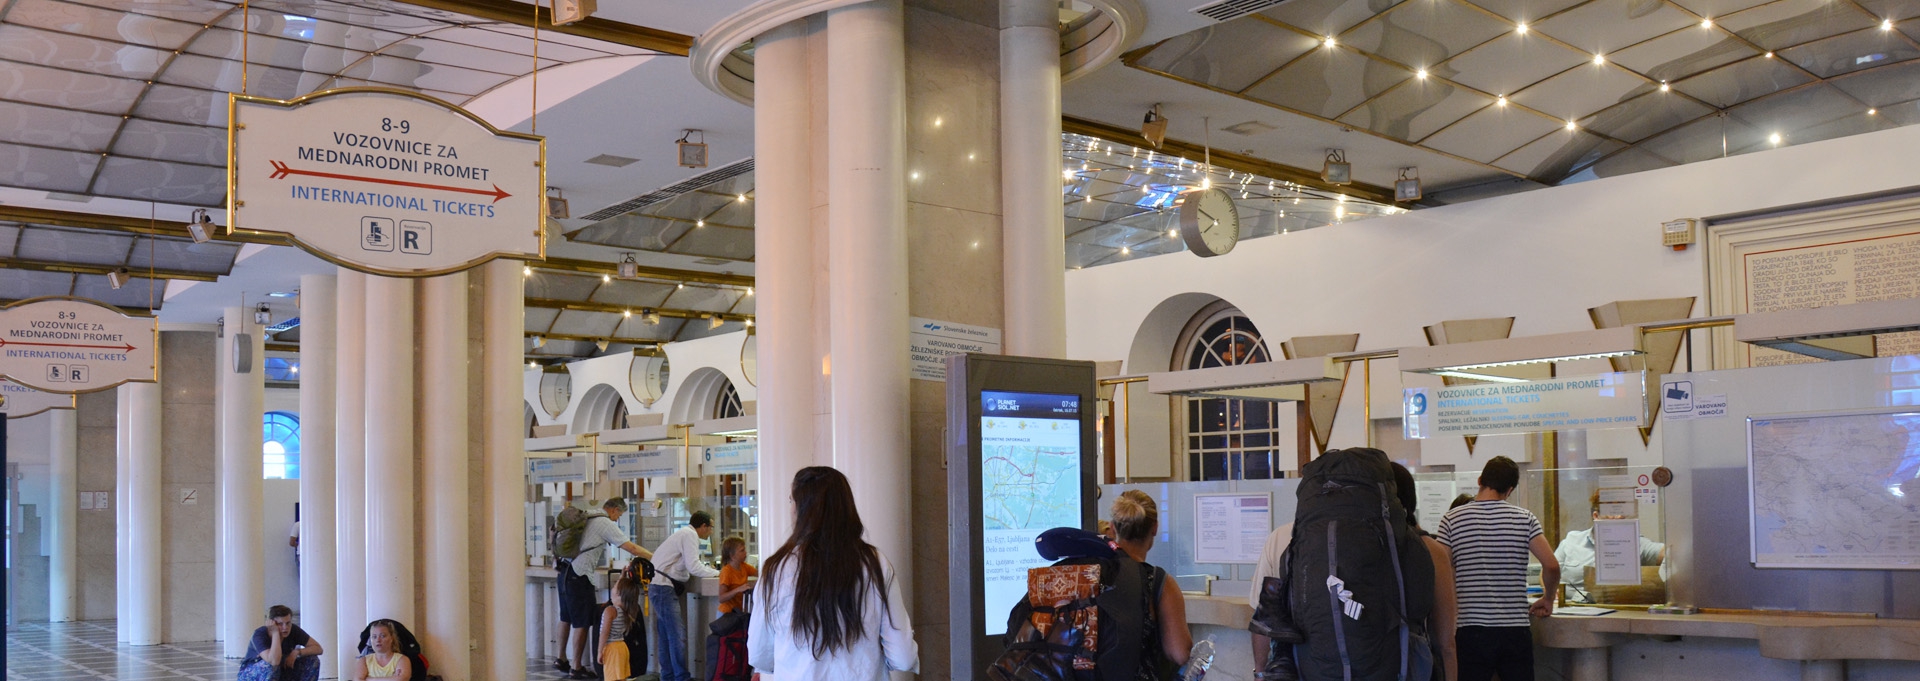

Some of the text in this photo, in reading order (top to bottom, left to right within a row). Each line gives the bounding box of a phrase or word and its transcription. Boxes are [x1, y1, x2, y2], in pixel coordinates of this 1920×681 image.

[382, 118, 410, 134] 8-9
[334, 132, 458, 160] VOZOVNICE ZA
[298, 146, 489, 180] MEDNARODNI PROMET
[292, 185, 494, 218] INTERNATIONAL TICKETS
[404, 230, 419, 250] R
[1762, 256, 1793, 264] POSTAJNO
[1802, 263, 1832, 271] DRŽAVNO
[1820, 285, 1846, 294] NAMREČ
[58, 311, 76, 320] 8-9
[30, 320, 88, 330] VOZOVNICE
[10, 329, 123, 342] MEDNARODNI PROMET
[928, 340, 983, 352] VAROVANO OBMOČJE
[6, 350, 127, 361] INTERNATIONAL TICKETS
[912, 355, 938, 363] OBMOČJE
[72, 370, 81, 380] R
[1437, 379, 1605, 399] VOZOVNICE ZA MEDNARODNI PROMET
[1413, 392, 1427, 415] 9
[1438, 394, 1540, 408] INTERNATIONAL TICKETS
[706, 448, 711, 461] 6
[530, 462, 535, 473] 4
[610, 456, 615, 468] 5
